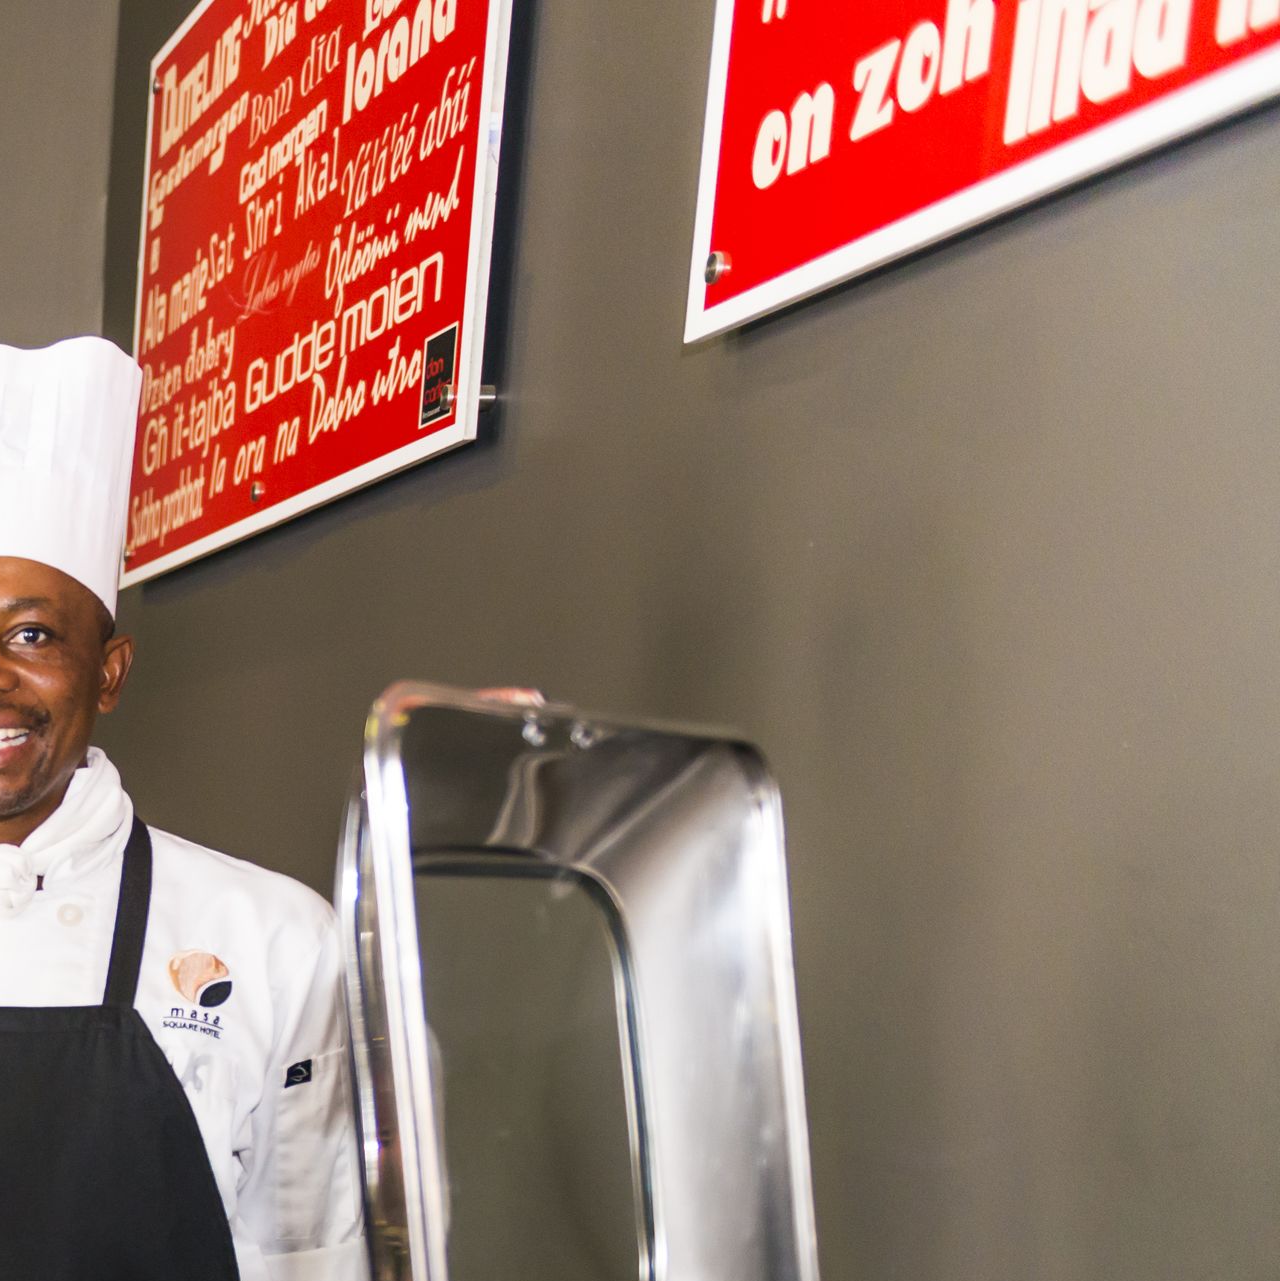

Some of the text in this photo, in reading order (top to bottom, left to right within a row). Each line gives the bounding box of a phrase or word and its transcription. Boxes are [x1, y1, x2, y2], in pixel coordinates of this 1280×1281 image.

[249, 76, 293, 148] Bom
[300, 24, 342, 97] dia
[208, 223, 236, 289] Sat
[243, 172, 283, 260] Shri
[294, 126, 339, 220] Akal
[185, 316, 235, 385] dobry
[245, 251, 444, 414] Gudde moien
[233, 435, 266, 486] ora
[273, 416, 300, 464] na
[162, 1020, 221, 1039] SQUARE HOTEL
